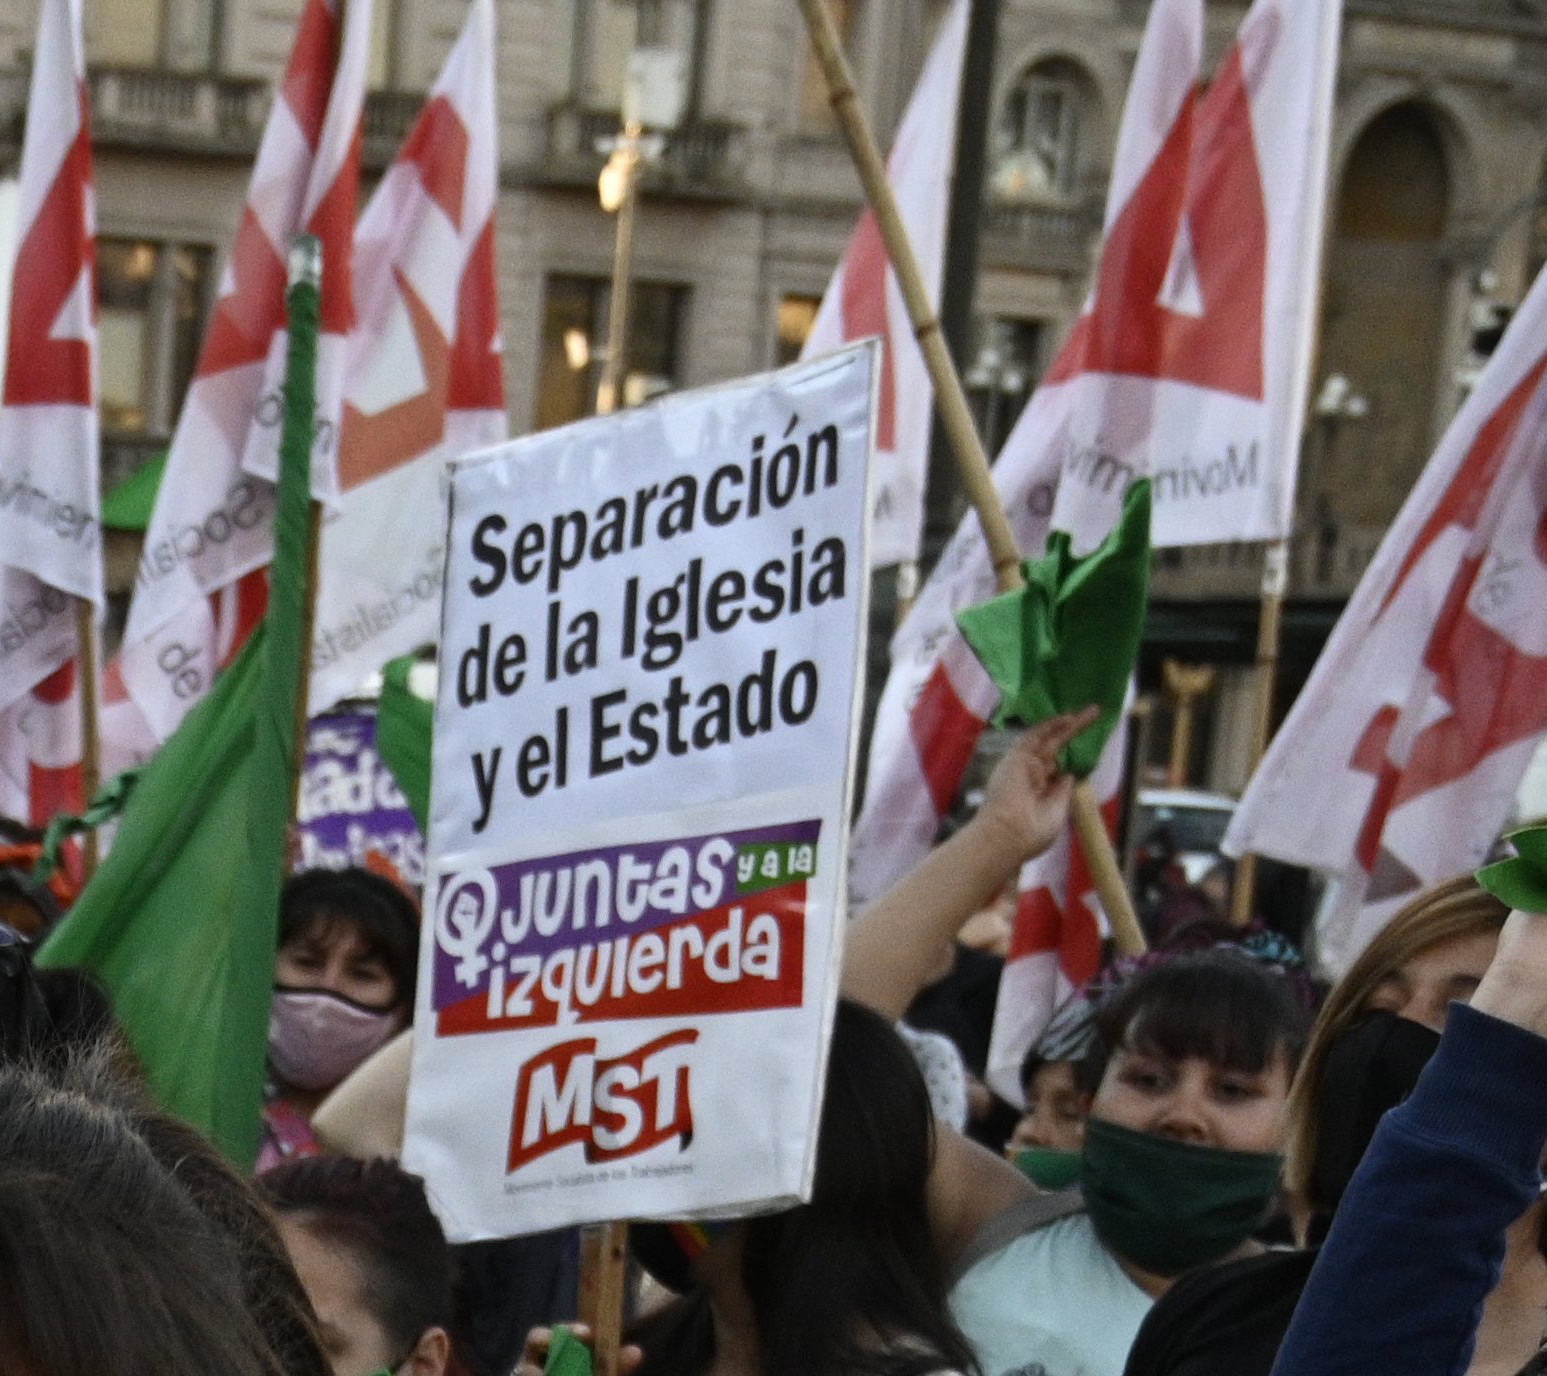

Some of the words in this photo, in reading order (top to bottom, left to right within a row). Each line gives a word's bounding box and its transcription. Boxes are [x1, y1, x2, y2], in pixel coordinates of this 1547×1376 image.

[468, 413, 840, 599] Separación
[457, 622, 527, 709] de
[545, 599, 599, 683] la
[620, 527, 847, 673] Iglesia
[471, 745, 502, 833] y
[516, 704, 568, 798] el
[589, 648, 819, 780] Estado
[520, 1038, 700, 1151] MST
